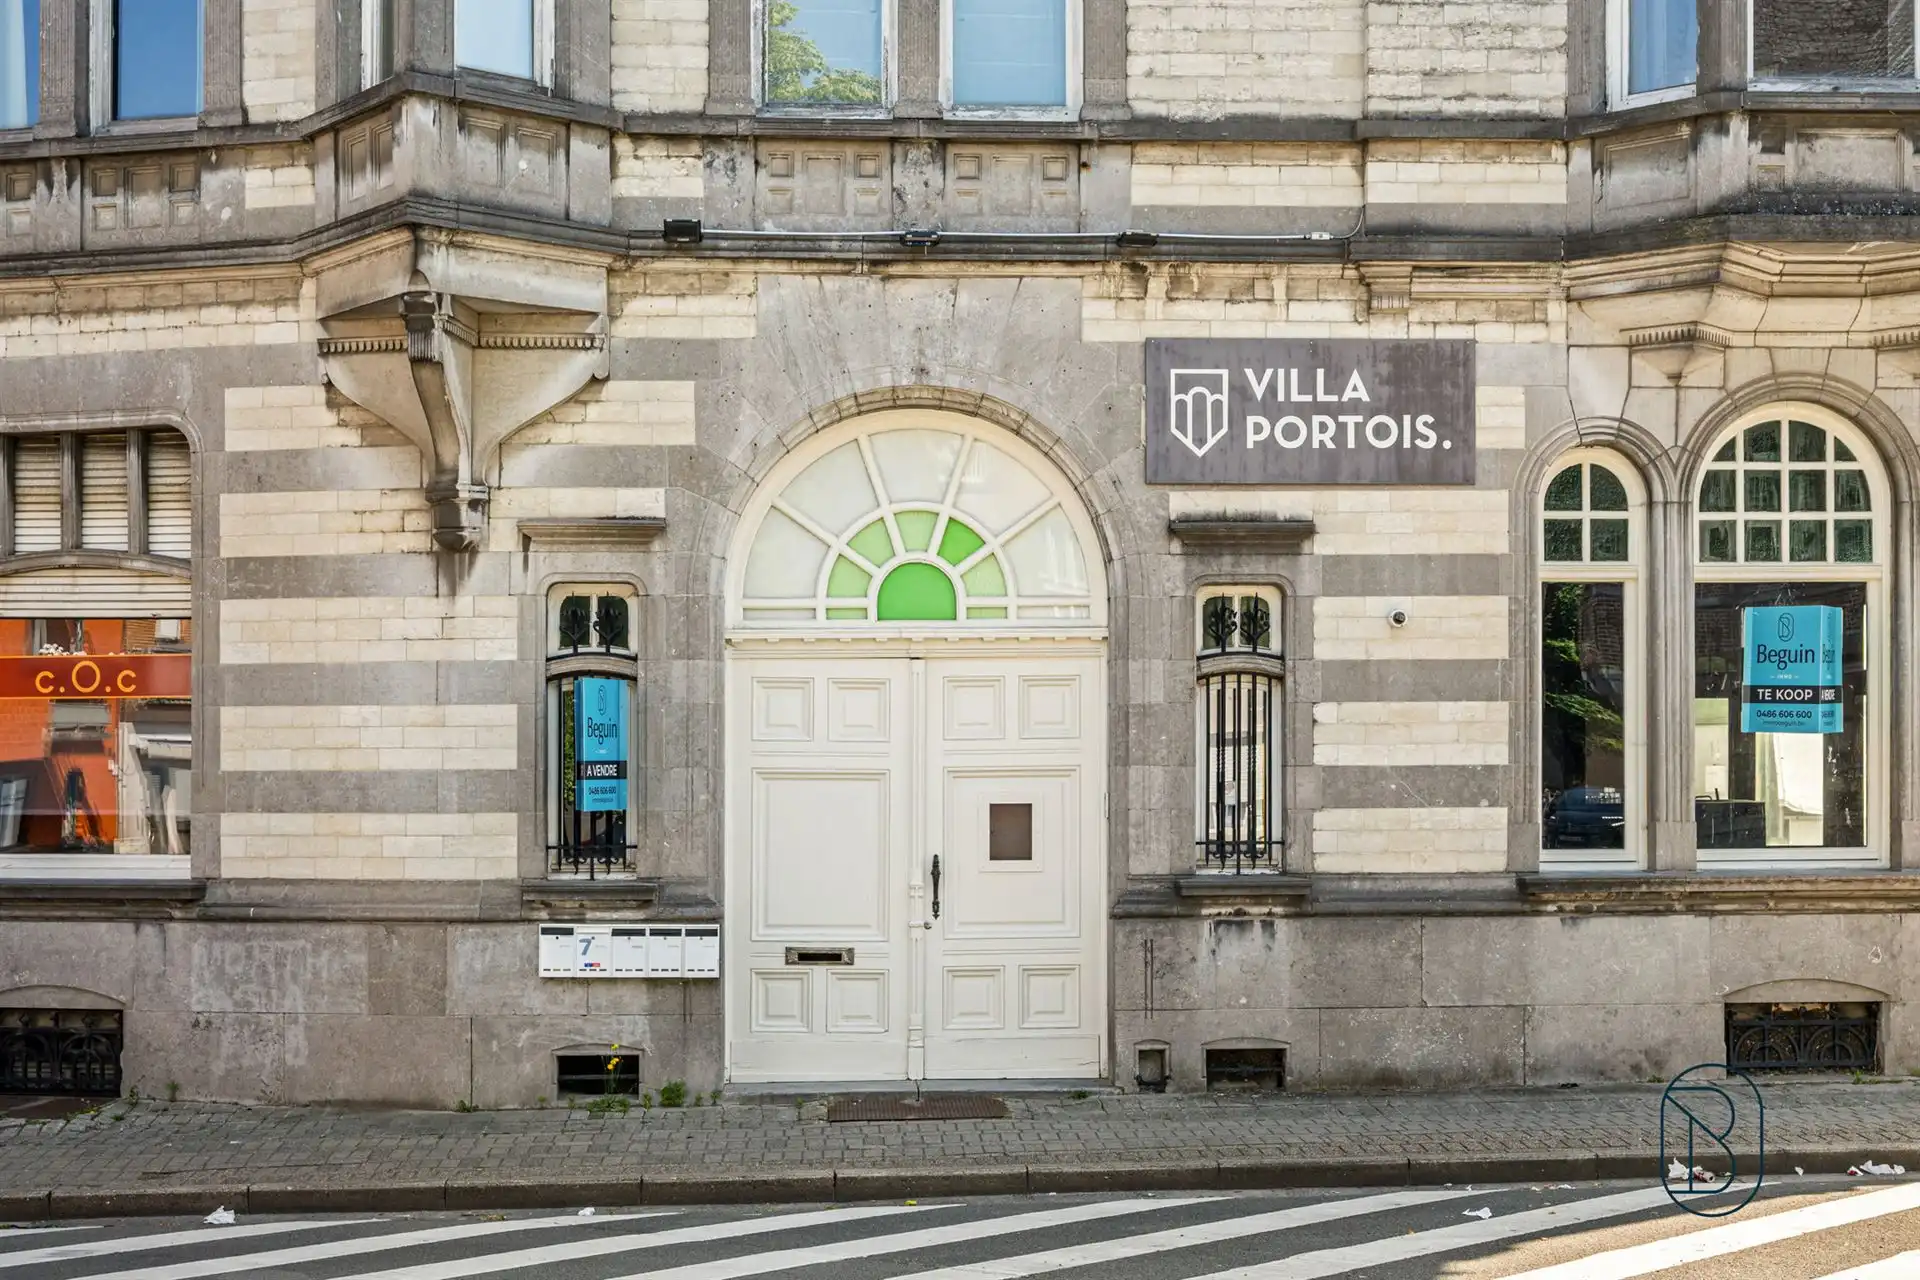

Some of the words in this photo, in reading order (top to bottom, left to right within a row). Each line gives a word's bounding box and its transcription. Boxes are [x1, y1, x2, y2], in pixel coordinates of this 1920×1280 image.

[1244, 368, 1371, 402] VILLA
[1246, 414, 1452, 449] PORTOIS.
[1756, 644, 1815, 671] Beguin
[1757, 688, 1772, 701] TE
[1776, 688, 1813, 701] KOOP
[1756, 709, 1777, 719] 0486
[1778, 710, 1795, 719] 606
[1796, 710, 1813, 719] 600
[587, 717, 618, 745] Beguin
[586, 764, 592, 777] A
[592, 764, 618, 777] VENDRE
[579, 938, 592, 956] 7
